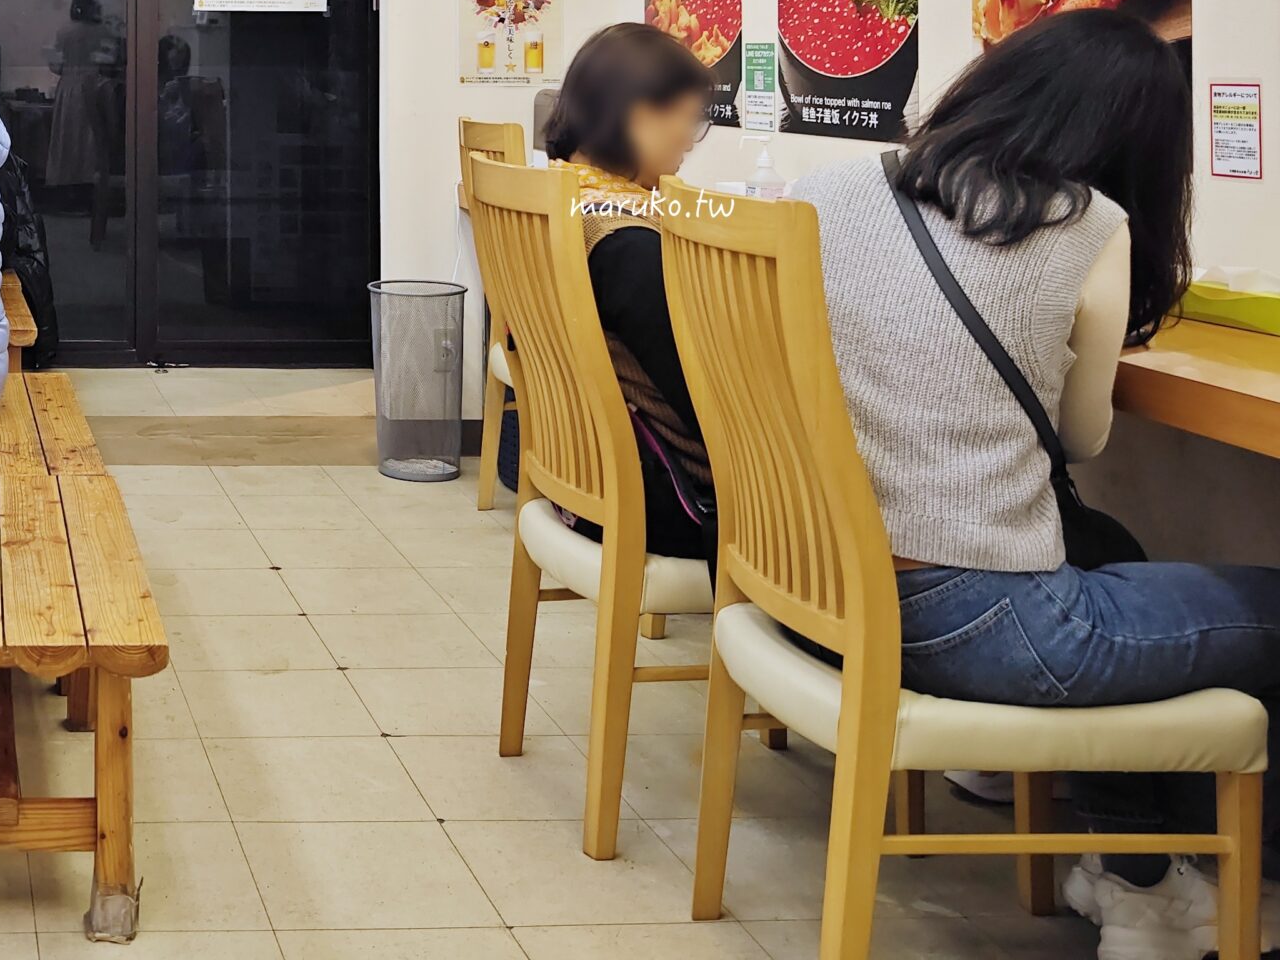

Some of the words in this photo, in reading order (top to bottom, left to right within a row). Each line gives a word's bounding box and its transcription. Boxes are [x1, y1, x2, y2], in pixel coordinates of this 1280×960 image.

[790, 93, 804, 104] Bowl
[812, 95, 823, 105] rice
[824, 96, 846, 109] topped
[846, 97, 860, 108] with
[861, 98, 881, 109] salmon
[881, 101, 892, 110] roe
[842, 112, 879, 129] イクラ丼
